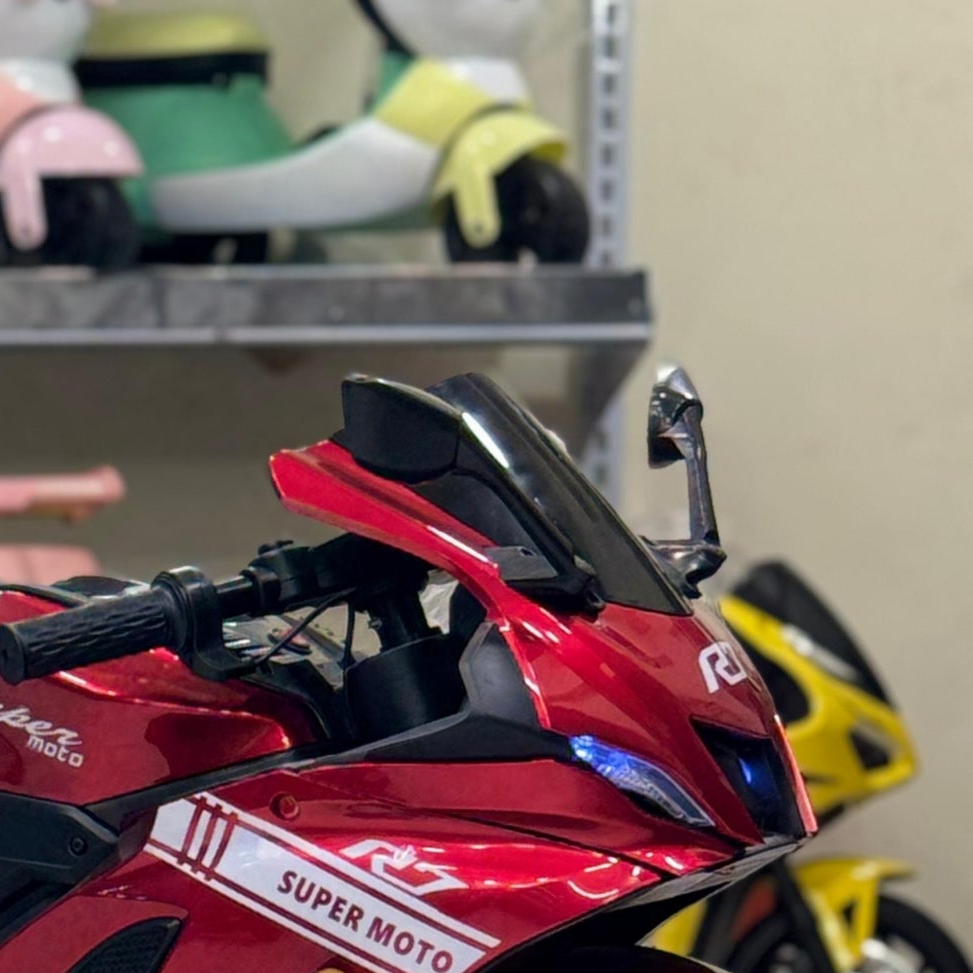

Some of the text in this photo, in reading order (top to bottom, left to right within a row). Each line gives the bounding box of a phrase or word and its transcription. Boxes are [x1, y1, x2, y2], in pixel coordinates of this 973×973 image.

[27, 735, 84, 768] moto
[277, 870, 453, 973] SUPER MOTO
